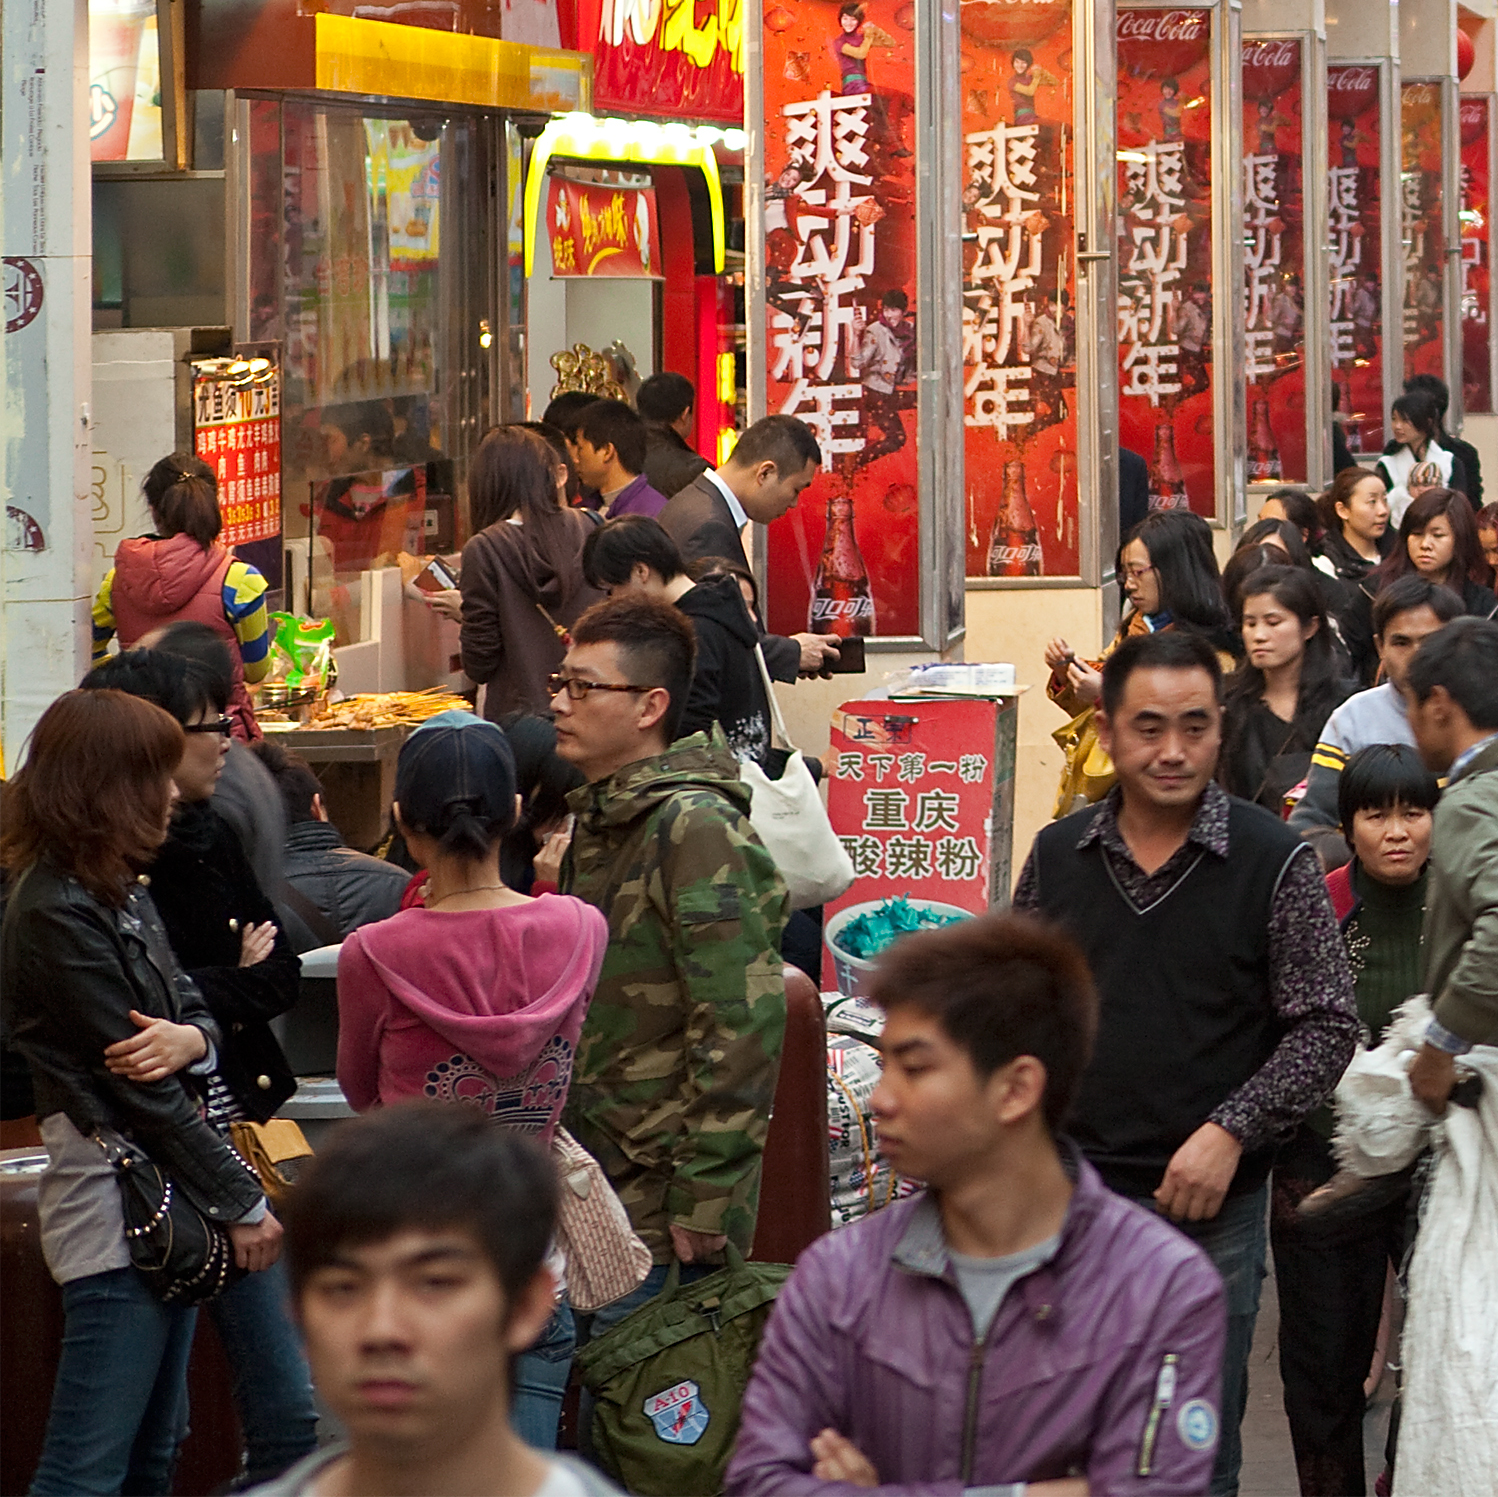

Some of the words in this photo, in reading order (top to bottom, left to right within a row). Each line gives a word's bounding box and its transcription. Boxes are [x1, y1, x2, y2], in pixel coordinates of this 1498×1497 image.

[771, 91, 875, 473] 爽动新年
[811, 595, 875, 623] 可口可乐
[836, 752, 988, 783] 天下第一粉
[862, 788, 960, 832] 重庆
[838, 835, 983, 879] 酸辣粉
[654, 1386, 690, 1412] A-10
